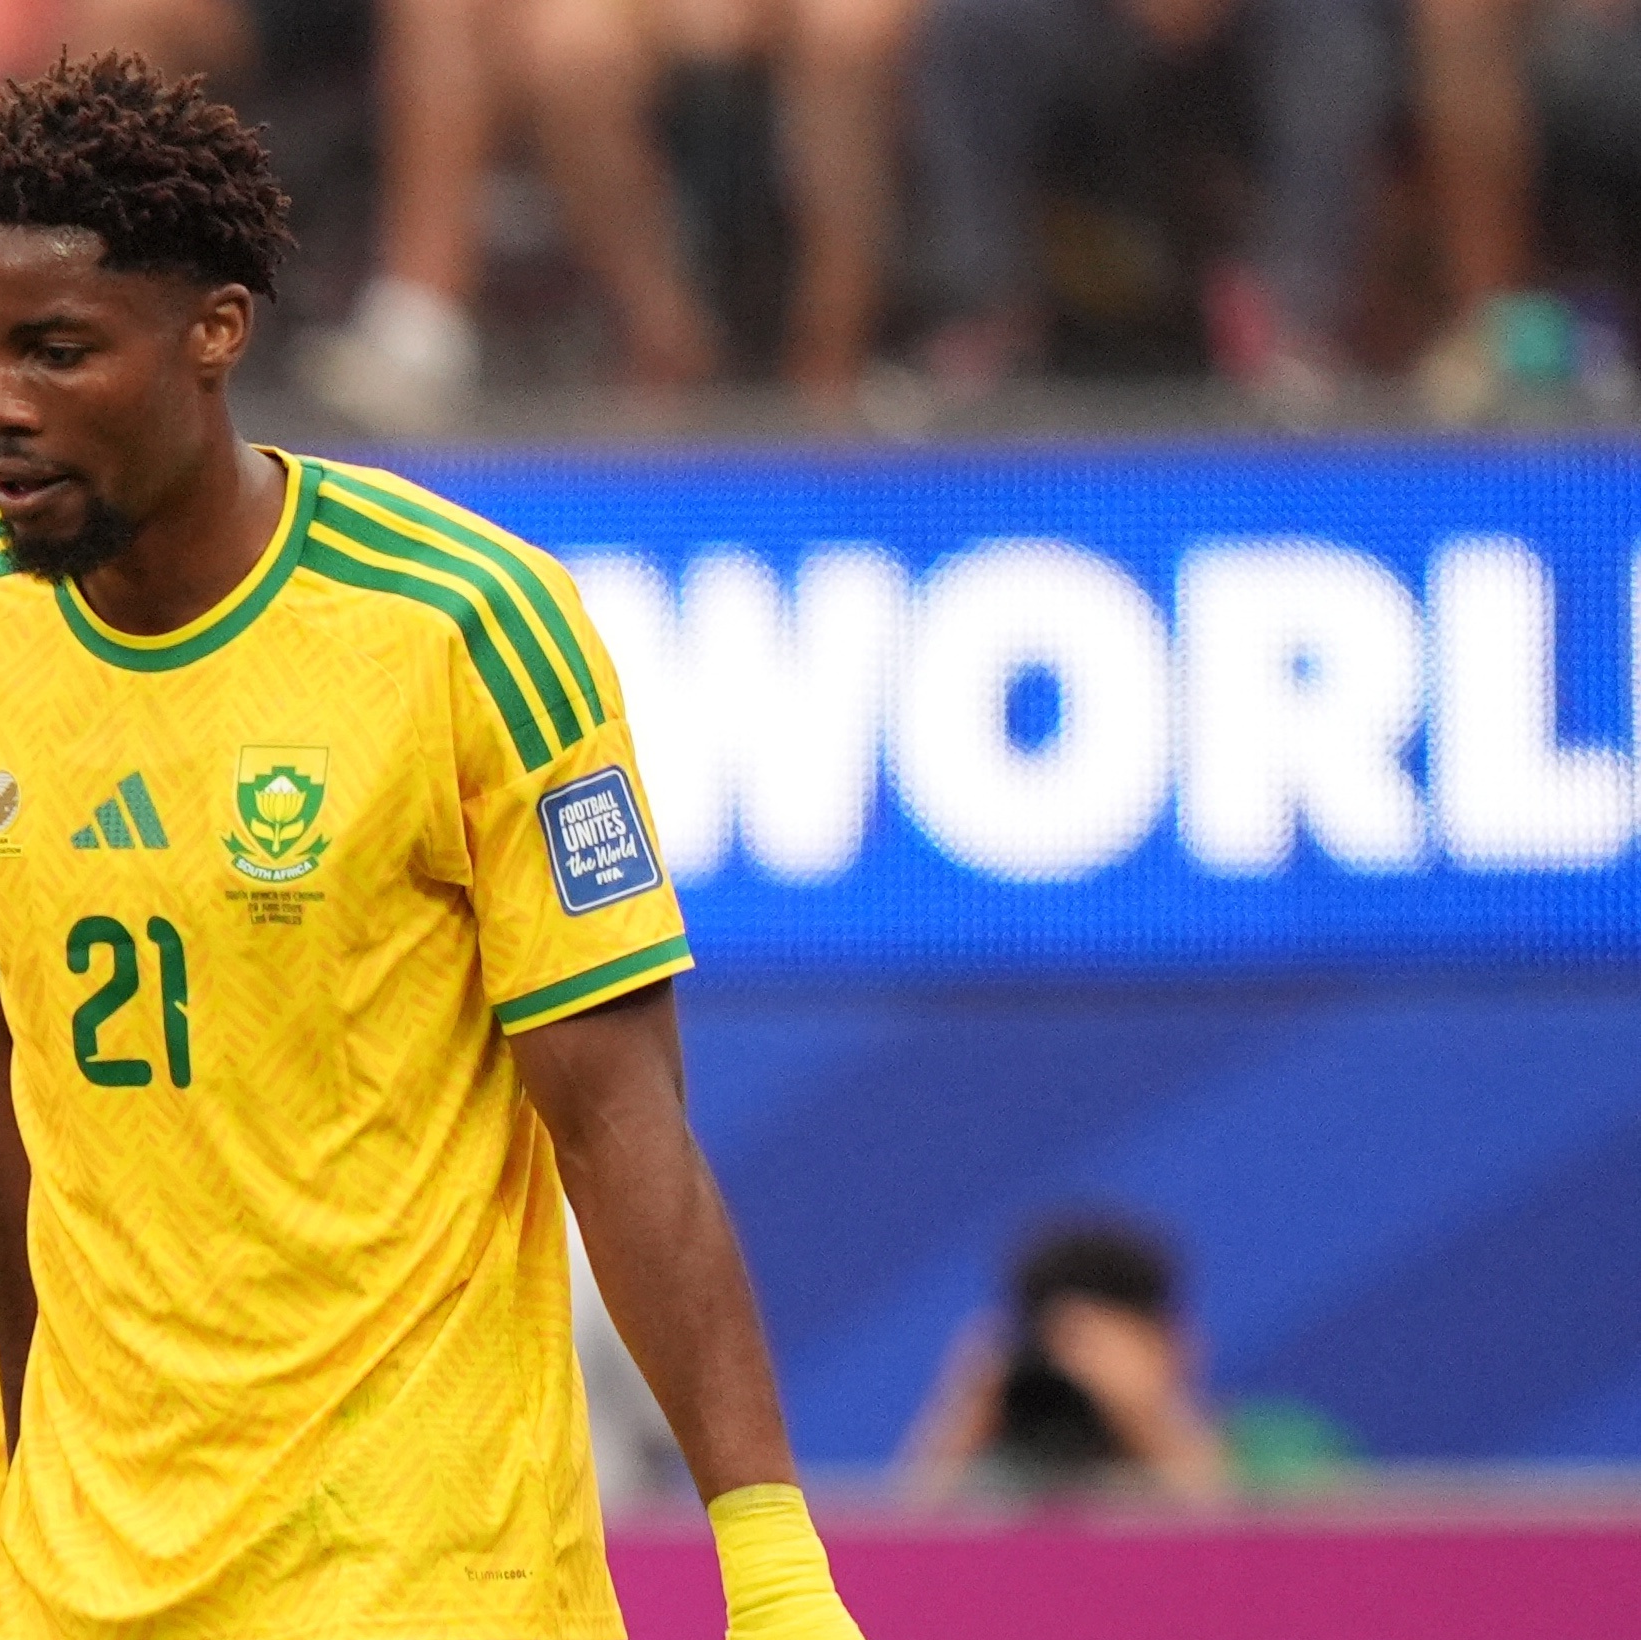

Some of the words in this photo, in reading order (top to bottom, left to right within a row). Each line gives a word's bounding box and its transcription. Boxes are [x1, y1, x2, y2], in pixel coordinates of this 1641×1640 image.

[559, 540, 1641, 886] WORL
[558, 789, 618, 827] FOOTBALL
[561, 809, 626, 852] UNITES
[236, 858, 272, 880] SOUTH
[273, 861, 313, 880] AFRICA
[565, 852, 596, 878] the
[594, 833, 638, 869] World
[595, 867, 624, 885] FIFA
[66, 915, 192, 1089] 21
